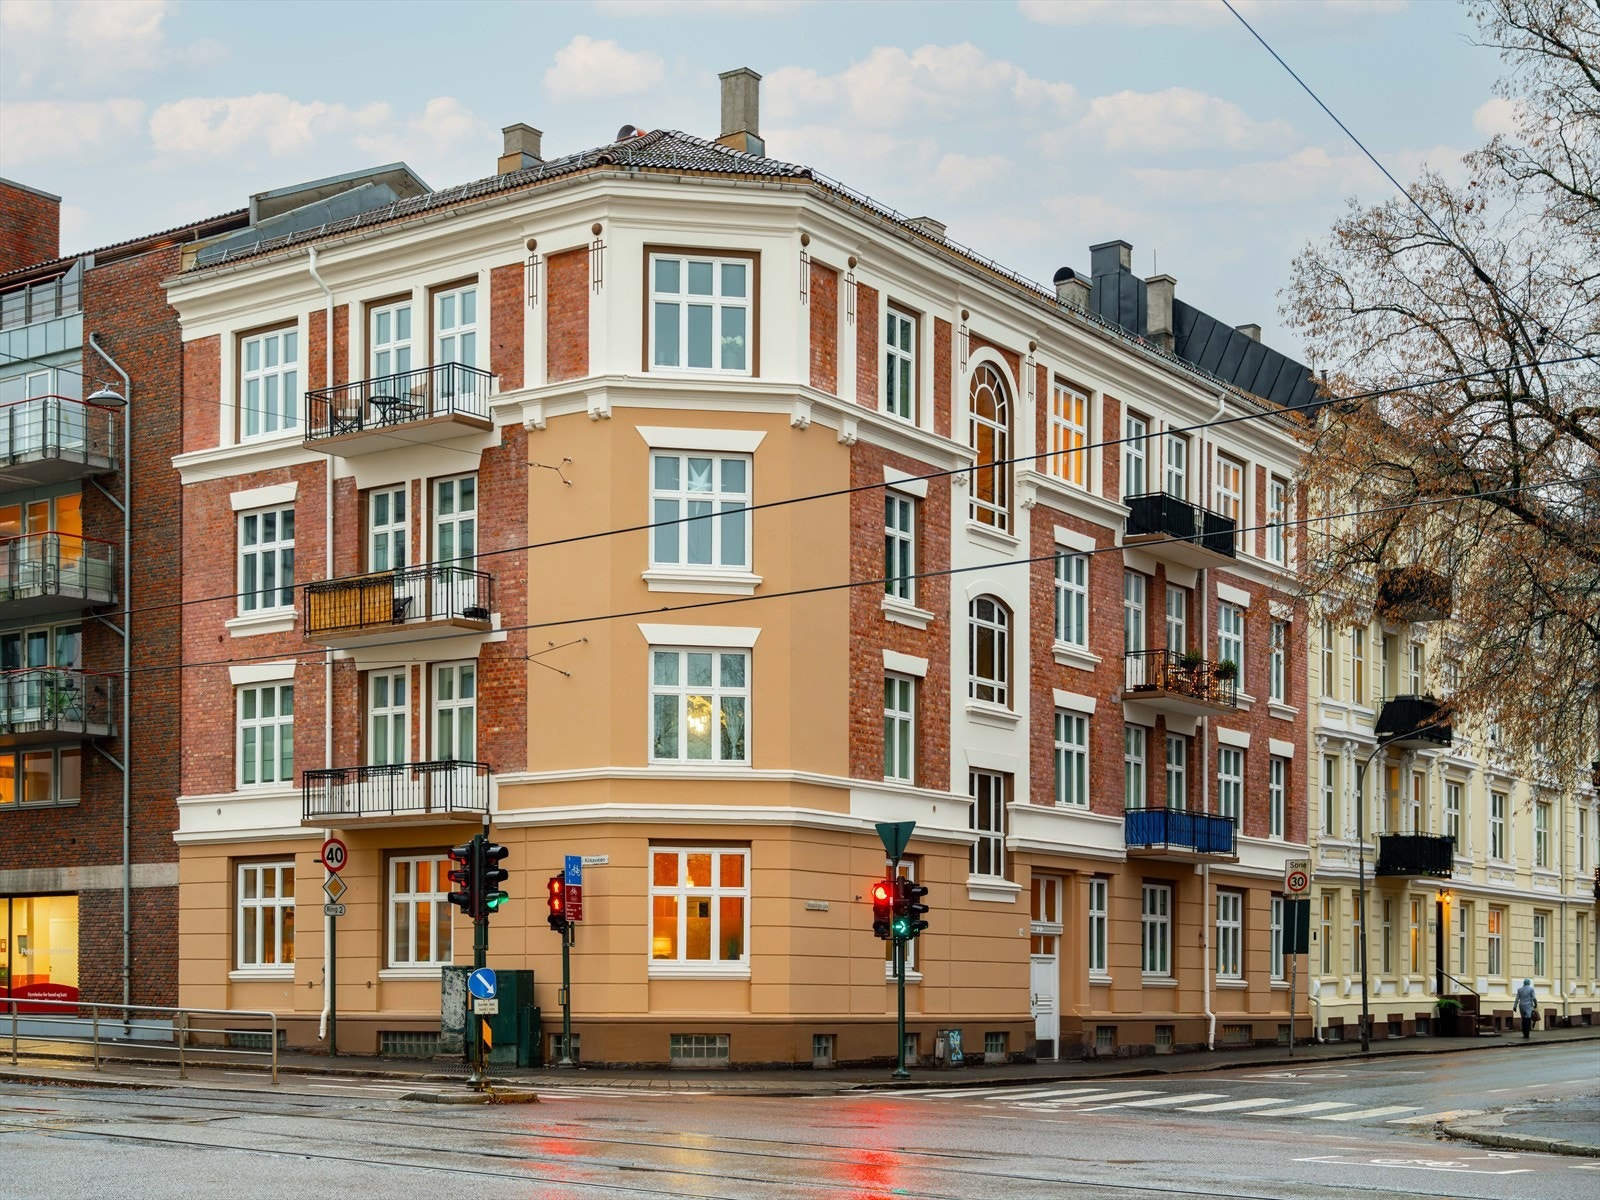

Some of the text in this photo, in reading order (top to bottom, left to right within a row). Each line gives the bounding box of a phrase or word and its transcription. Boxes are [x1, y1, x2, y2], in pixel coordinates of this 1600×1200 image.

[326, 847, 344, 864] 40
[1291, 876, 1305, 887] 30
[326, 906, 344, 914] Ring 2
